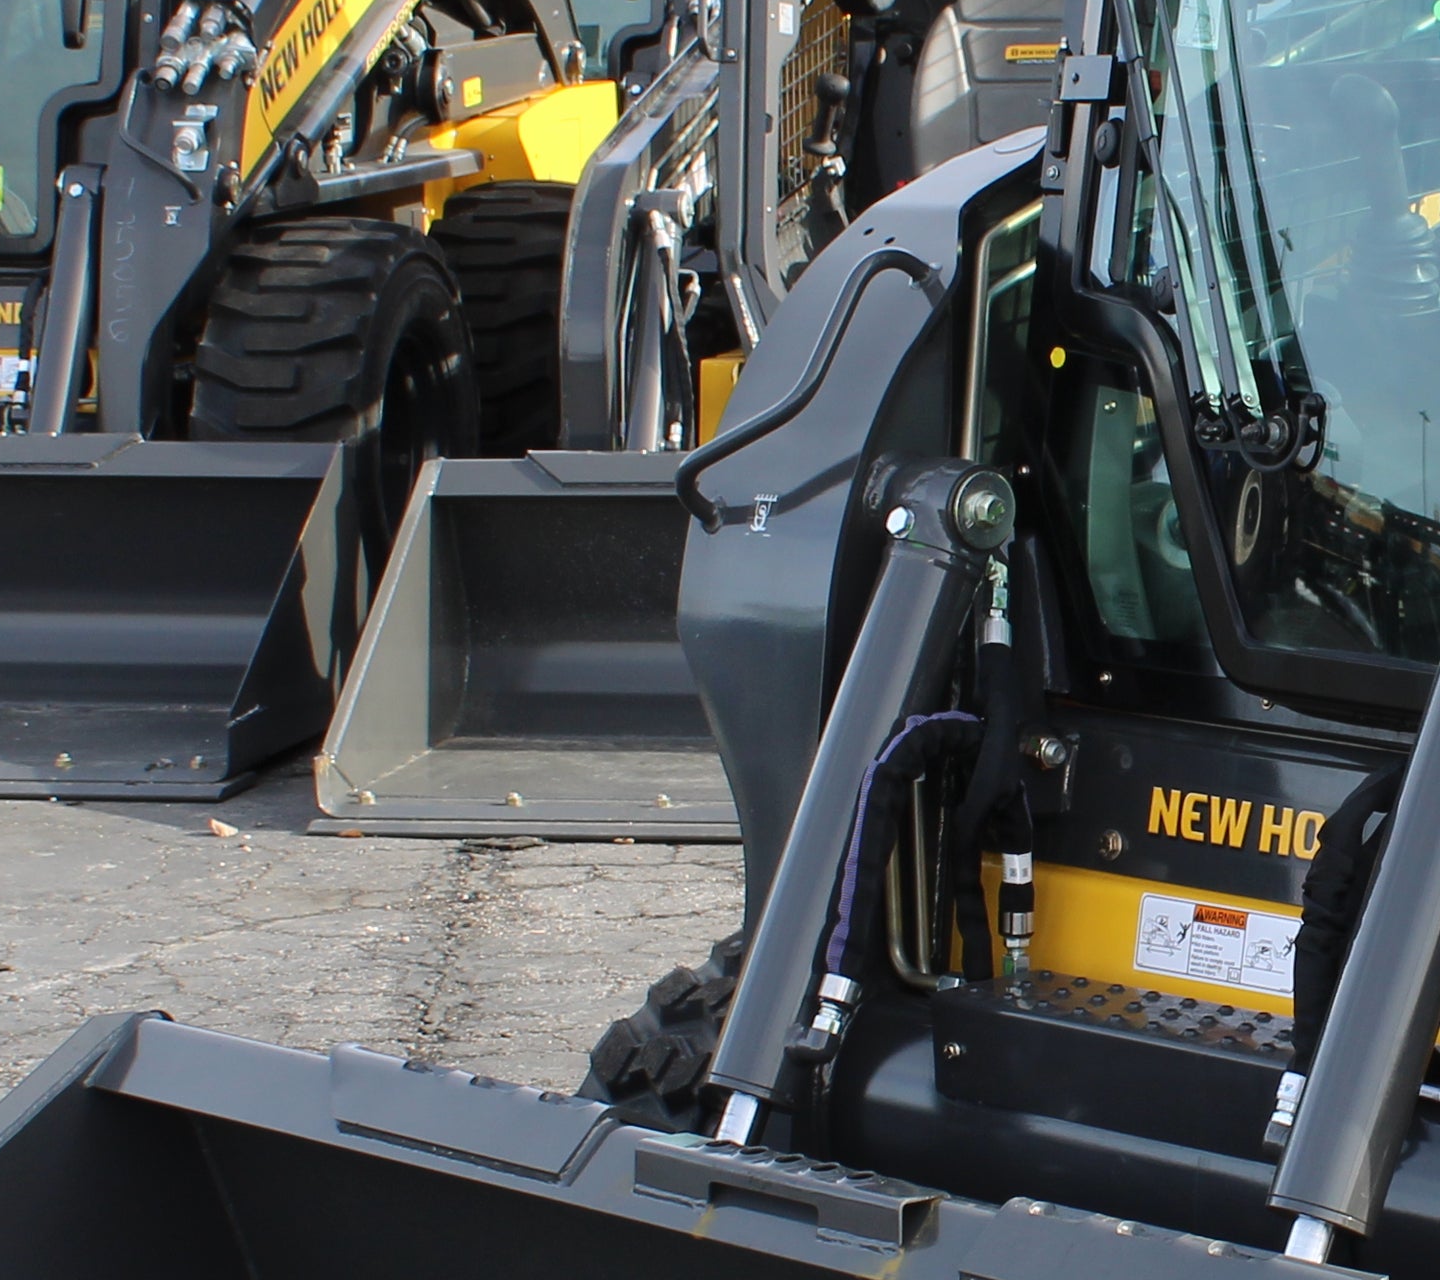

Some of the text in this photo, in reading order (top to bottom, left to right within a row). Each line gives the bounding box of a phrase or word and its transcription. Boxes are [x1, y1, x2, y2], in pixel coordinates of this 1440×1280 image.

[259, 33, 299, 111] NEW
[1148, 786, 1252, 849] NEW
[1196, 924, 1213, 934] FALL
[1213, 925, 1241, 939] HAZARD
[1204, 909, 1245, 928] WARNING
